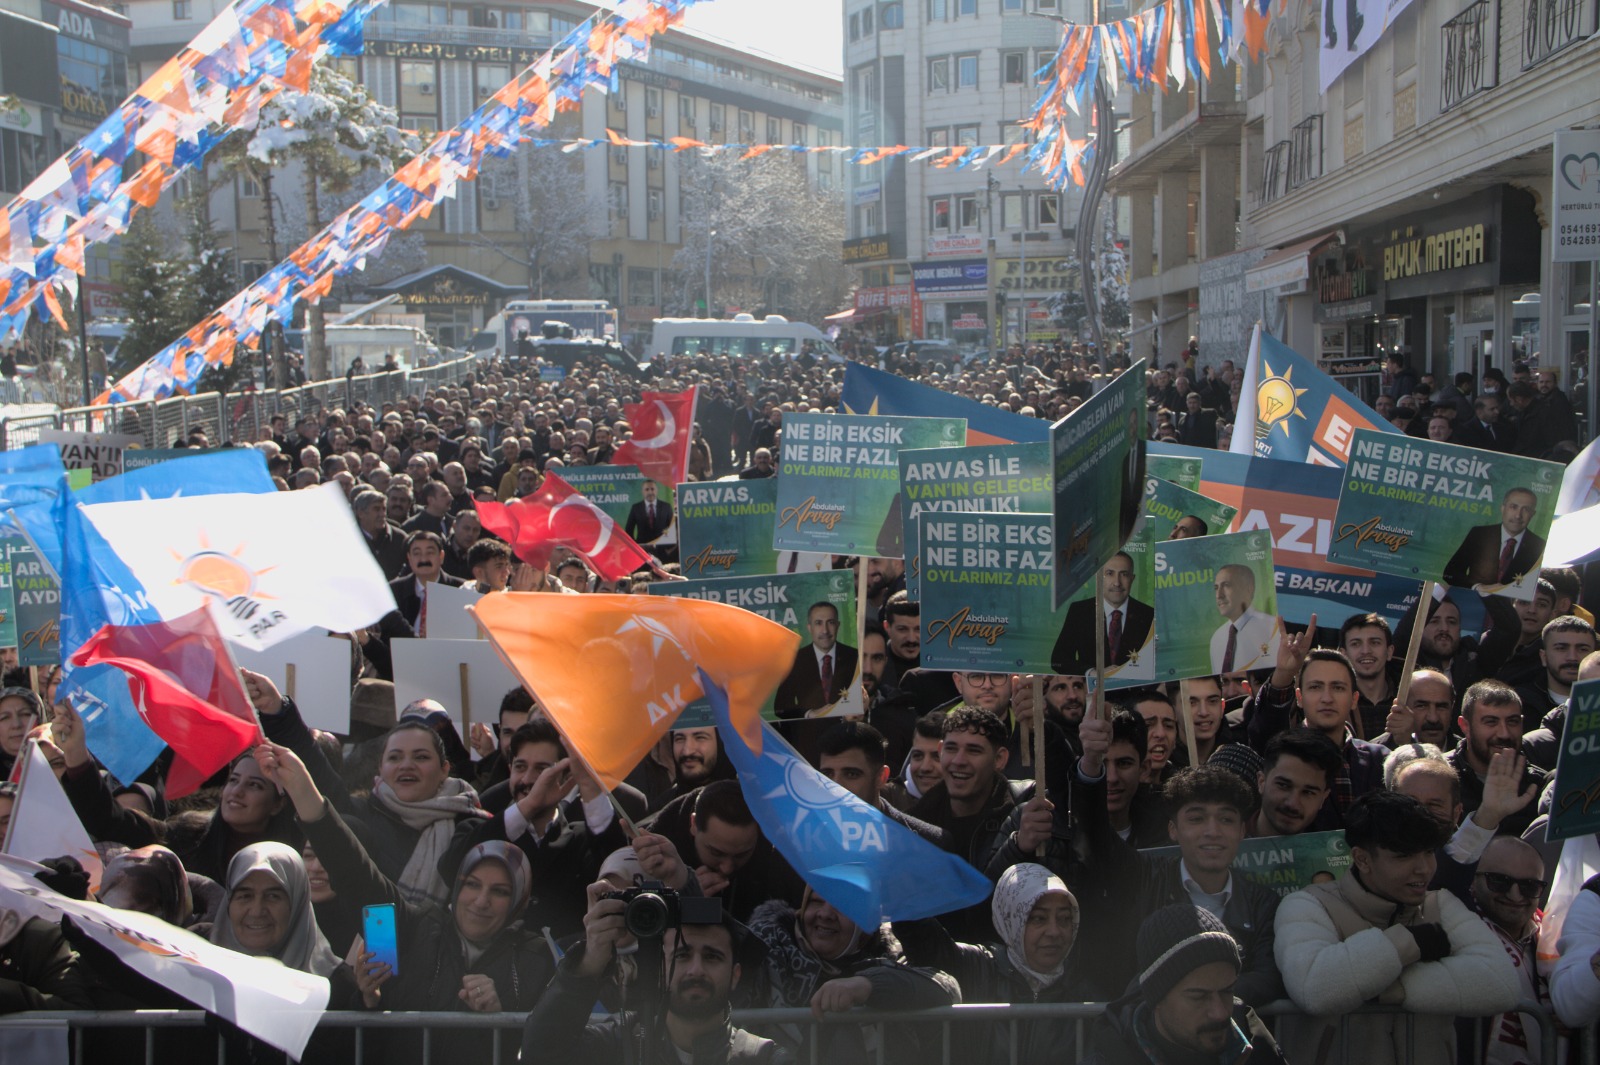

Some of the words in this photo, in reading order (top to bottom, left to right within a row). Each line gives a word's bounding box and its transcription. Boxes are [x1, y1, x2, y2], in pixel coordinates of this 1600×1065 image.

[60, 9, 95, 40] ADA
[385, 43, 457, 59] URARTU
[465, 46, 513, 62] OTELİ
[1384, 225, 1421, 281] BÜYÜK
[1425, 224, 1484, 273] MATBAA
[1108, 389, 1125, 413] VAN
[786, 422, 811, 440] NE
[814, 420, 843, 442] BİR
[847, 422, 904, 445] EKSİK
[784, 444, 808, 462] NE
[812, 442, 842, 464] BİR
[846, 447, 899, 466] FAZL
[1356, 439, 1386, 460] NE
[1388, 444, 1423, 467] BİR
[1426, 452, 1492, 480] EKSİK
[586, 473, 614, 481] ARVAS
[783, 464, 851, 478] OYLARIMIZ
[905, 459, 985, 482] ARVAS
[988, 454, 1021, 477] İLE
[905, 481, 969, 499] VAN'IN
[1351, 461, 1380, 481] NE
[1383, 465, 1419, 488] BİR
[1421, 474, 1494, 503] FAZLA
[682, 486, 753, 505] ARVAS,
[1348, 480, 1426, 505] OYLARIMIZ
[1427, 494, 1494, 517] ARVAS'A
[682, 505, 729, 519] VAN'IN
[811, 503, 846, 513] Abdulahat
[926, 522, 957, 542] NE
[962, 518, 1000, 544] BİR
[1005, 524, 1052, 545] EKS
[1374, 522, 1415, 537] Abdulahat
[927, 547, 957, 567] NE
[962, 543, 1000, 568] BİR
[1005, 550, 1053, 570] FAZ
[927, 569, 1013, 585] OYLARIMIZ
[1155, 568, 1215, 590] MUDU!
[1289, 574, 1373, 599] BAŞKANI
[725, 581, 789, 606] EKSİK
[966, 614, 1009, 624] Abdulahat
[1386, 603, 1411, 612] EDREMİ
[646, 683, 688, 727] AK
[840, 821, 889, 853] PA
[1251, 848, 1295, 867] VAN
